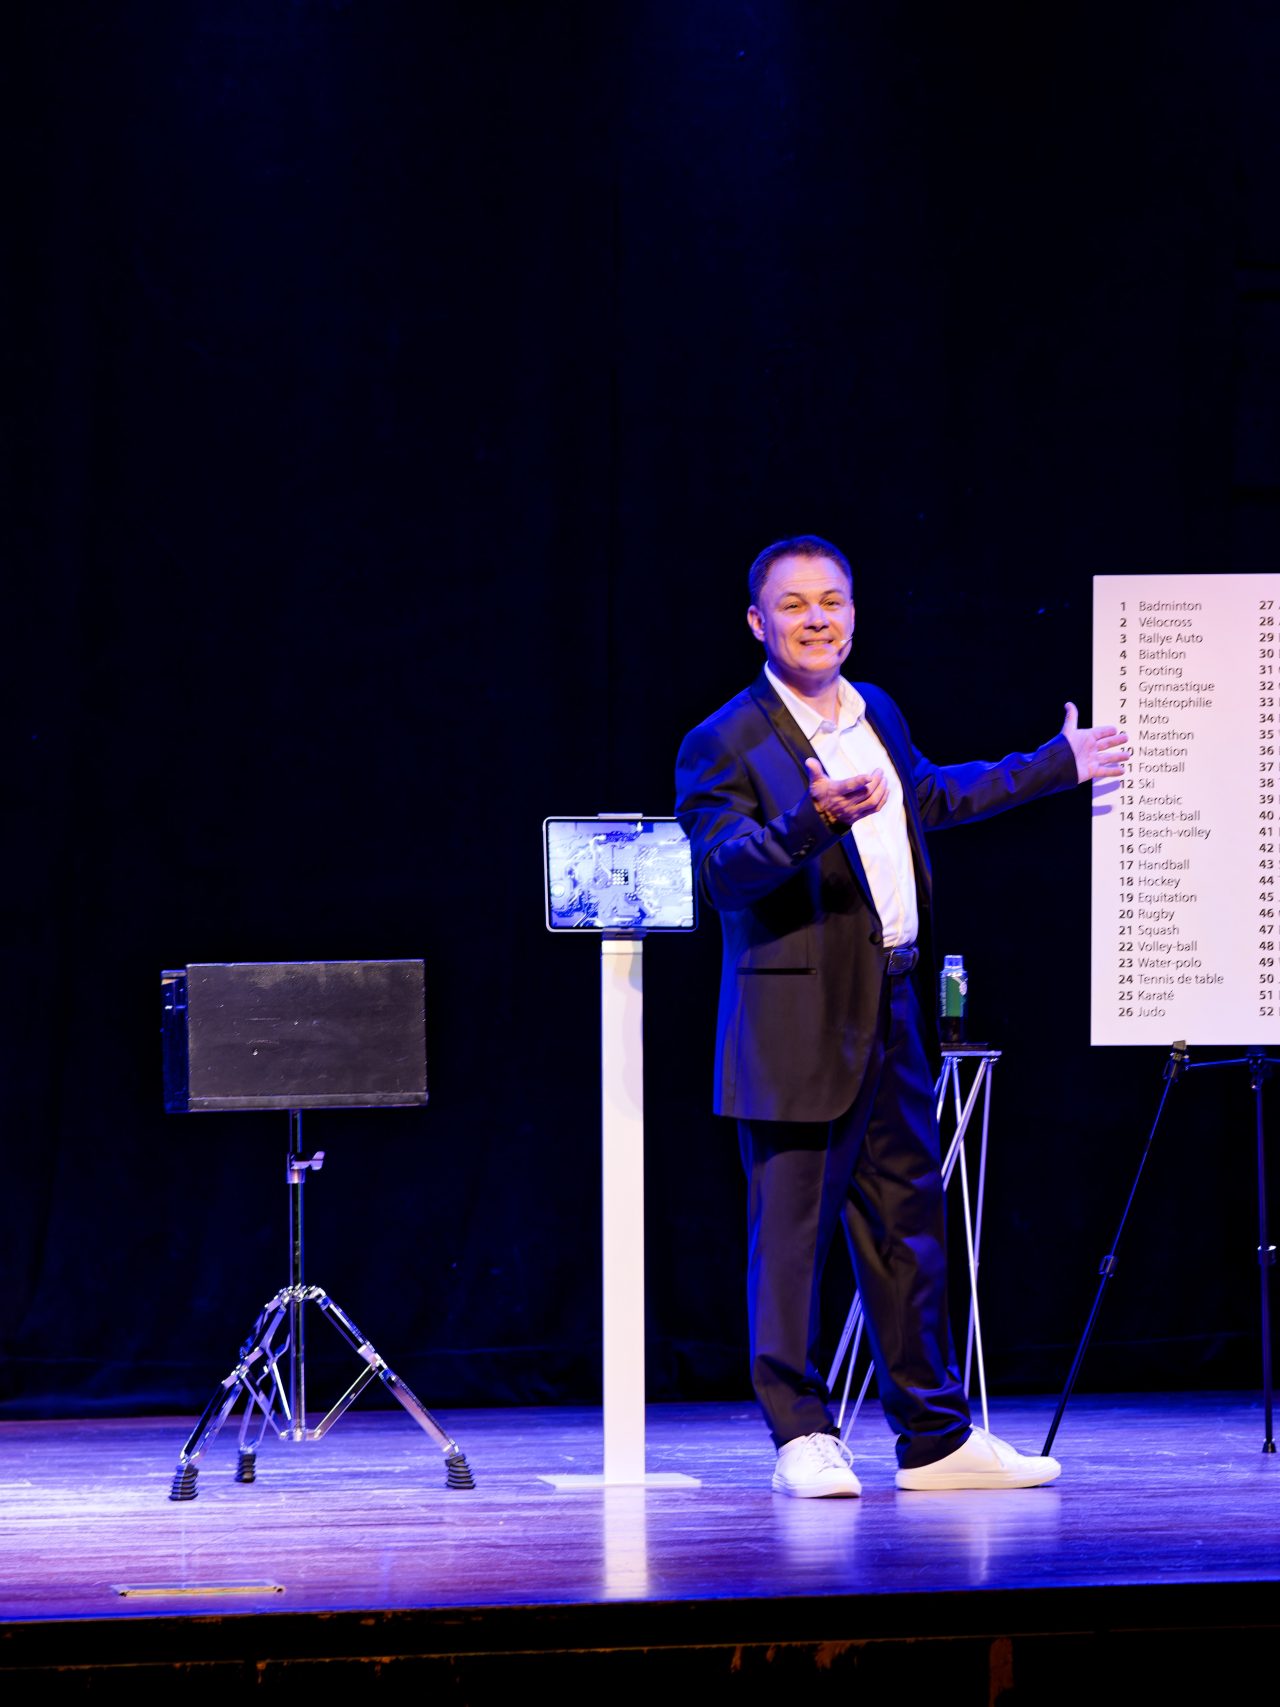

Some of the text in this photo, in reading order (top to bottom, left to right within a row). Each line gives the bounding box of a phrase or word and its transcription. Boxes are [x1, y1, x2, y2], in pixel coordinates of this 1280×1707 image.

[1120, 600, 1202, 612] 1 Badminton
[1258, 599, 1275, 611] 27
[1119, 616, 1193, 628] 2 Vélocross
[1258, 616, 1275, 627] 28
[1119, 632, 1204, 647] 3 Rallye Auto
[1258, 632, 1275, 643] 29
[1119, 648, 1187, 660] 4 Biathlon
[1258, 648, 1275, 659] 30
[1119, 665, 1183, 679] 5 Footing
[1258, 664, 1273, 676] 31
[1119, 680, 1216, 695] 6 Gymnastique
[1258, 680, 1275, 692] 32
[1119, 696, 1213, 711] 7 Haltérophilie
[1258, 696, 1275, 708] 33
[1119, 713, 1170, 725] 8 Moto
[1258, 712, 1275, 724] 34
[1138, 729, 1195, 741] Marathon
[1258, 729, 1275, 740] 35
[1138, 745, 1188, 757] Natation
[1258, 745, 1275, 757] 36
[1138, 761, 1185, 774] Football
[1258, 761, 1275, 773] 37
[1120, 777, 1155, 790] 12 Ski
[1259, 777, 1275, 789] 38
[1119, 793, 1183, 806] 13 Aerobic
[1258, 793, 1275, 805] 39
[1119, 809, 1201, 822] 14 Basket-ball
[1258, 809, 1275, 821] 40
[1119, 825, 1212, 841] 15 Beach-volley
[1258, 826, 1273, 837] 41
[1119, 842, 1163, 855] 16 Golf
[1258, 842, 1275, 854] 42
[1119, 858, 1190, 871] 17 Handball
[1258, 859, 1275, 870] 43
[1119, 875, 1181, 890] 18 Hockey
[1258, 875, 1275, 886] 44
[1119, 891, 1198, 906] 19 Equitation
[1258, 891, 1275, 903] 45
[1118, 907, 1176, 922] 20 Rugby
[1258, 907, 1275, 919] 46
[1118, 924, 1180, 938] 21 Squash
[1258, 924, 1275, 935] 47
[1117, 940, 1198, 955] 22 Volley-ball
[1258, 940, 1275, 952] 48
[1118, 956, 1202, 971] 23 Water-polo
[1258, 956, 1275, 968] 49
[1117, 972, 1225, 985] 24 Tennis de table
[1258, 973, 1275, 985] 50
[1118, 989, 1175, 1001] 25 Karaté
[1258, 989, 1273, 1001] 51
[1117, 1006, 1166, 1018] 26 Judo
[1258, 1006, 1275, 1017] 52
